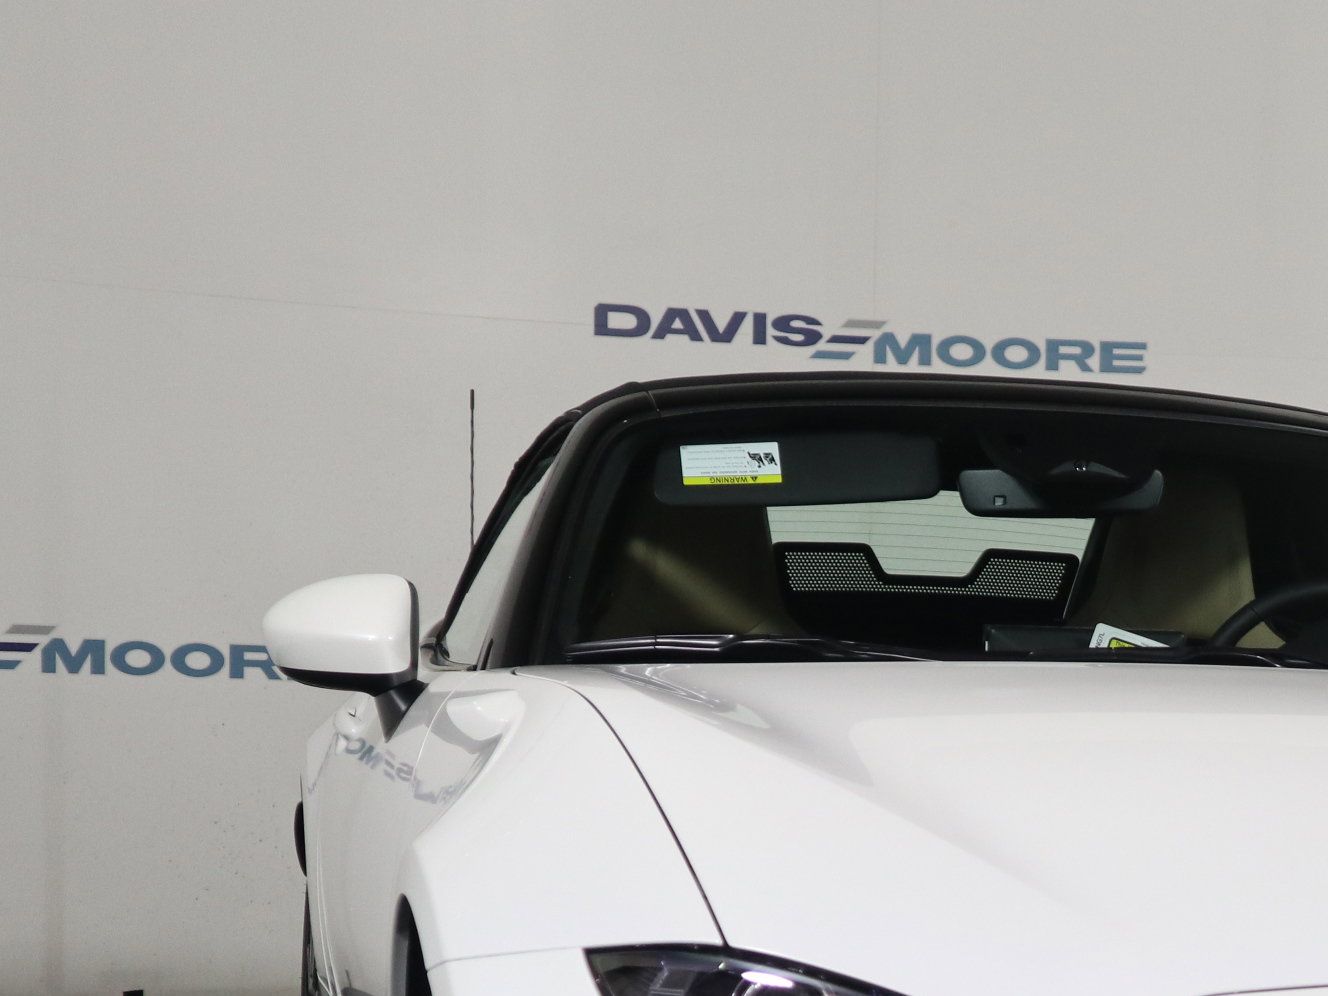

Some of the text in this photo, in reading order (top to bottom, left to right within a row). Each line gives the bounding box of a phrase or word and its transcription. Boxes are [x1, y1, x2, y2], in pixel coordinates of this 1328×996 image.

[593, 303, 1147, 375] DAVIS MOORE
[709, 475, 748, 484] WARNING
[41, 638, 297, 681] MOOR
